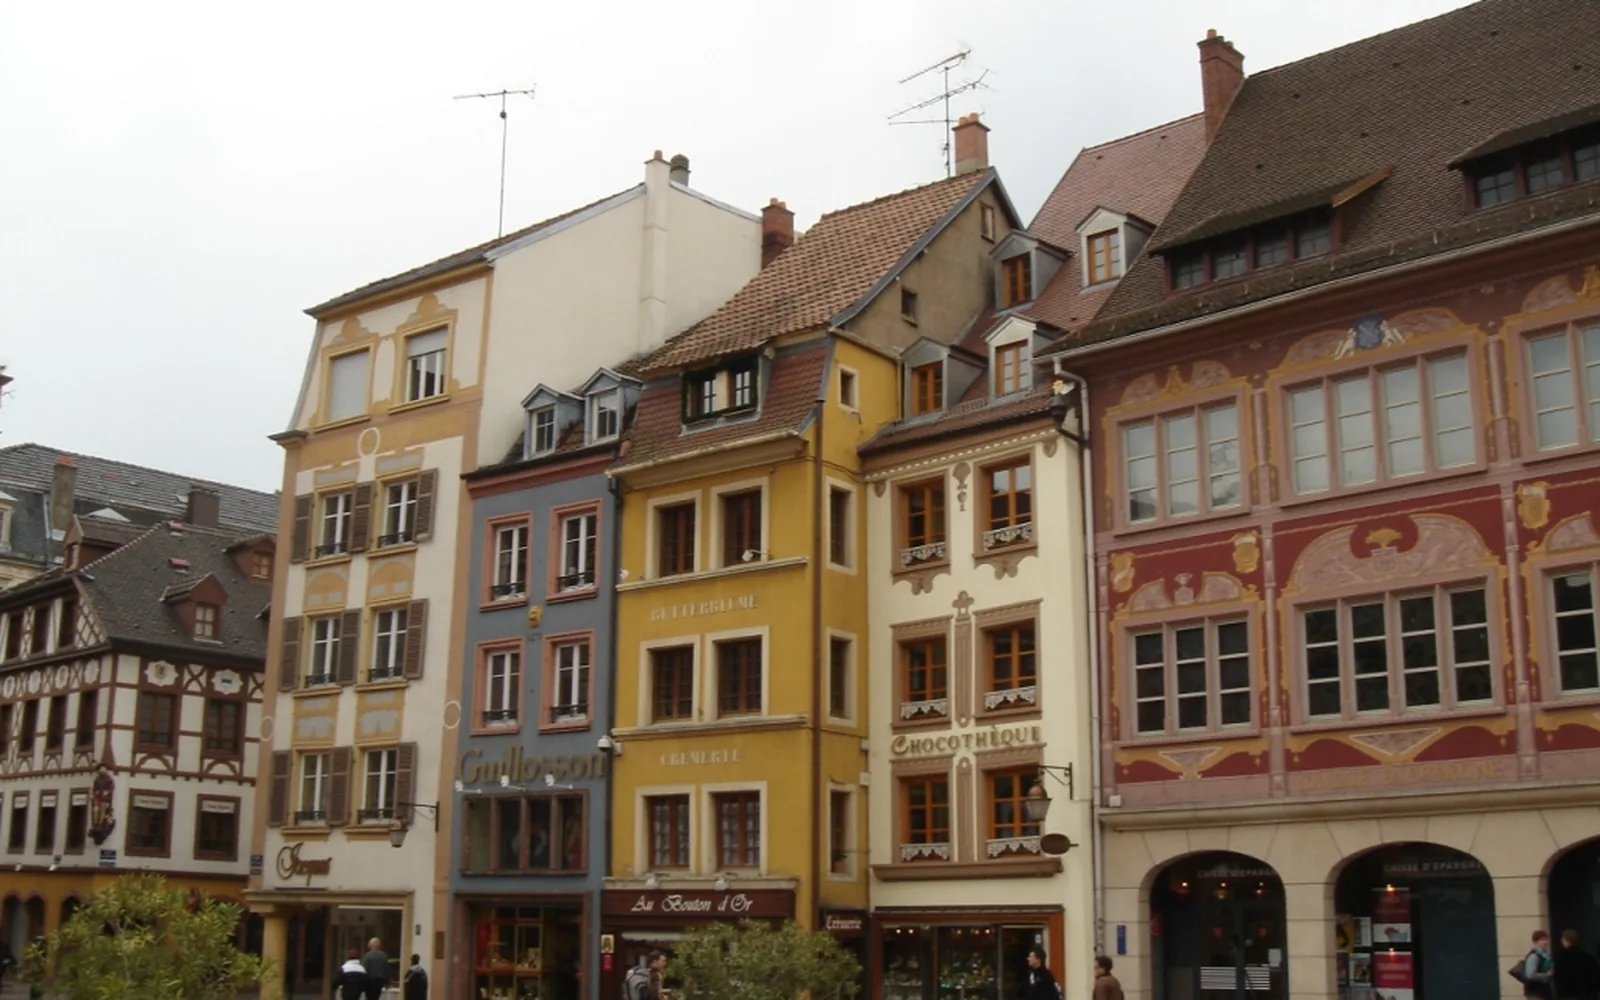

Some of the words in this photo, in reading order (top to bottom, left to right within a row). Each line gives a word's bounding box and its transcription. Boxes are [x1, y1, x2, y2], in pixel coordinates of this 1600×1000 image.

[890, 725, 1042, 756] CHOCOTHÈQUE
[459, 746, 606, 784] Guillosson
[631, 895, 654, 912] Au
[661, 893, 712, 912] Bouton
